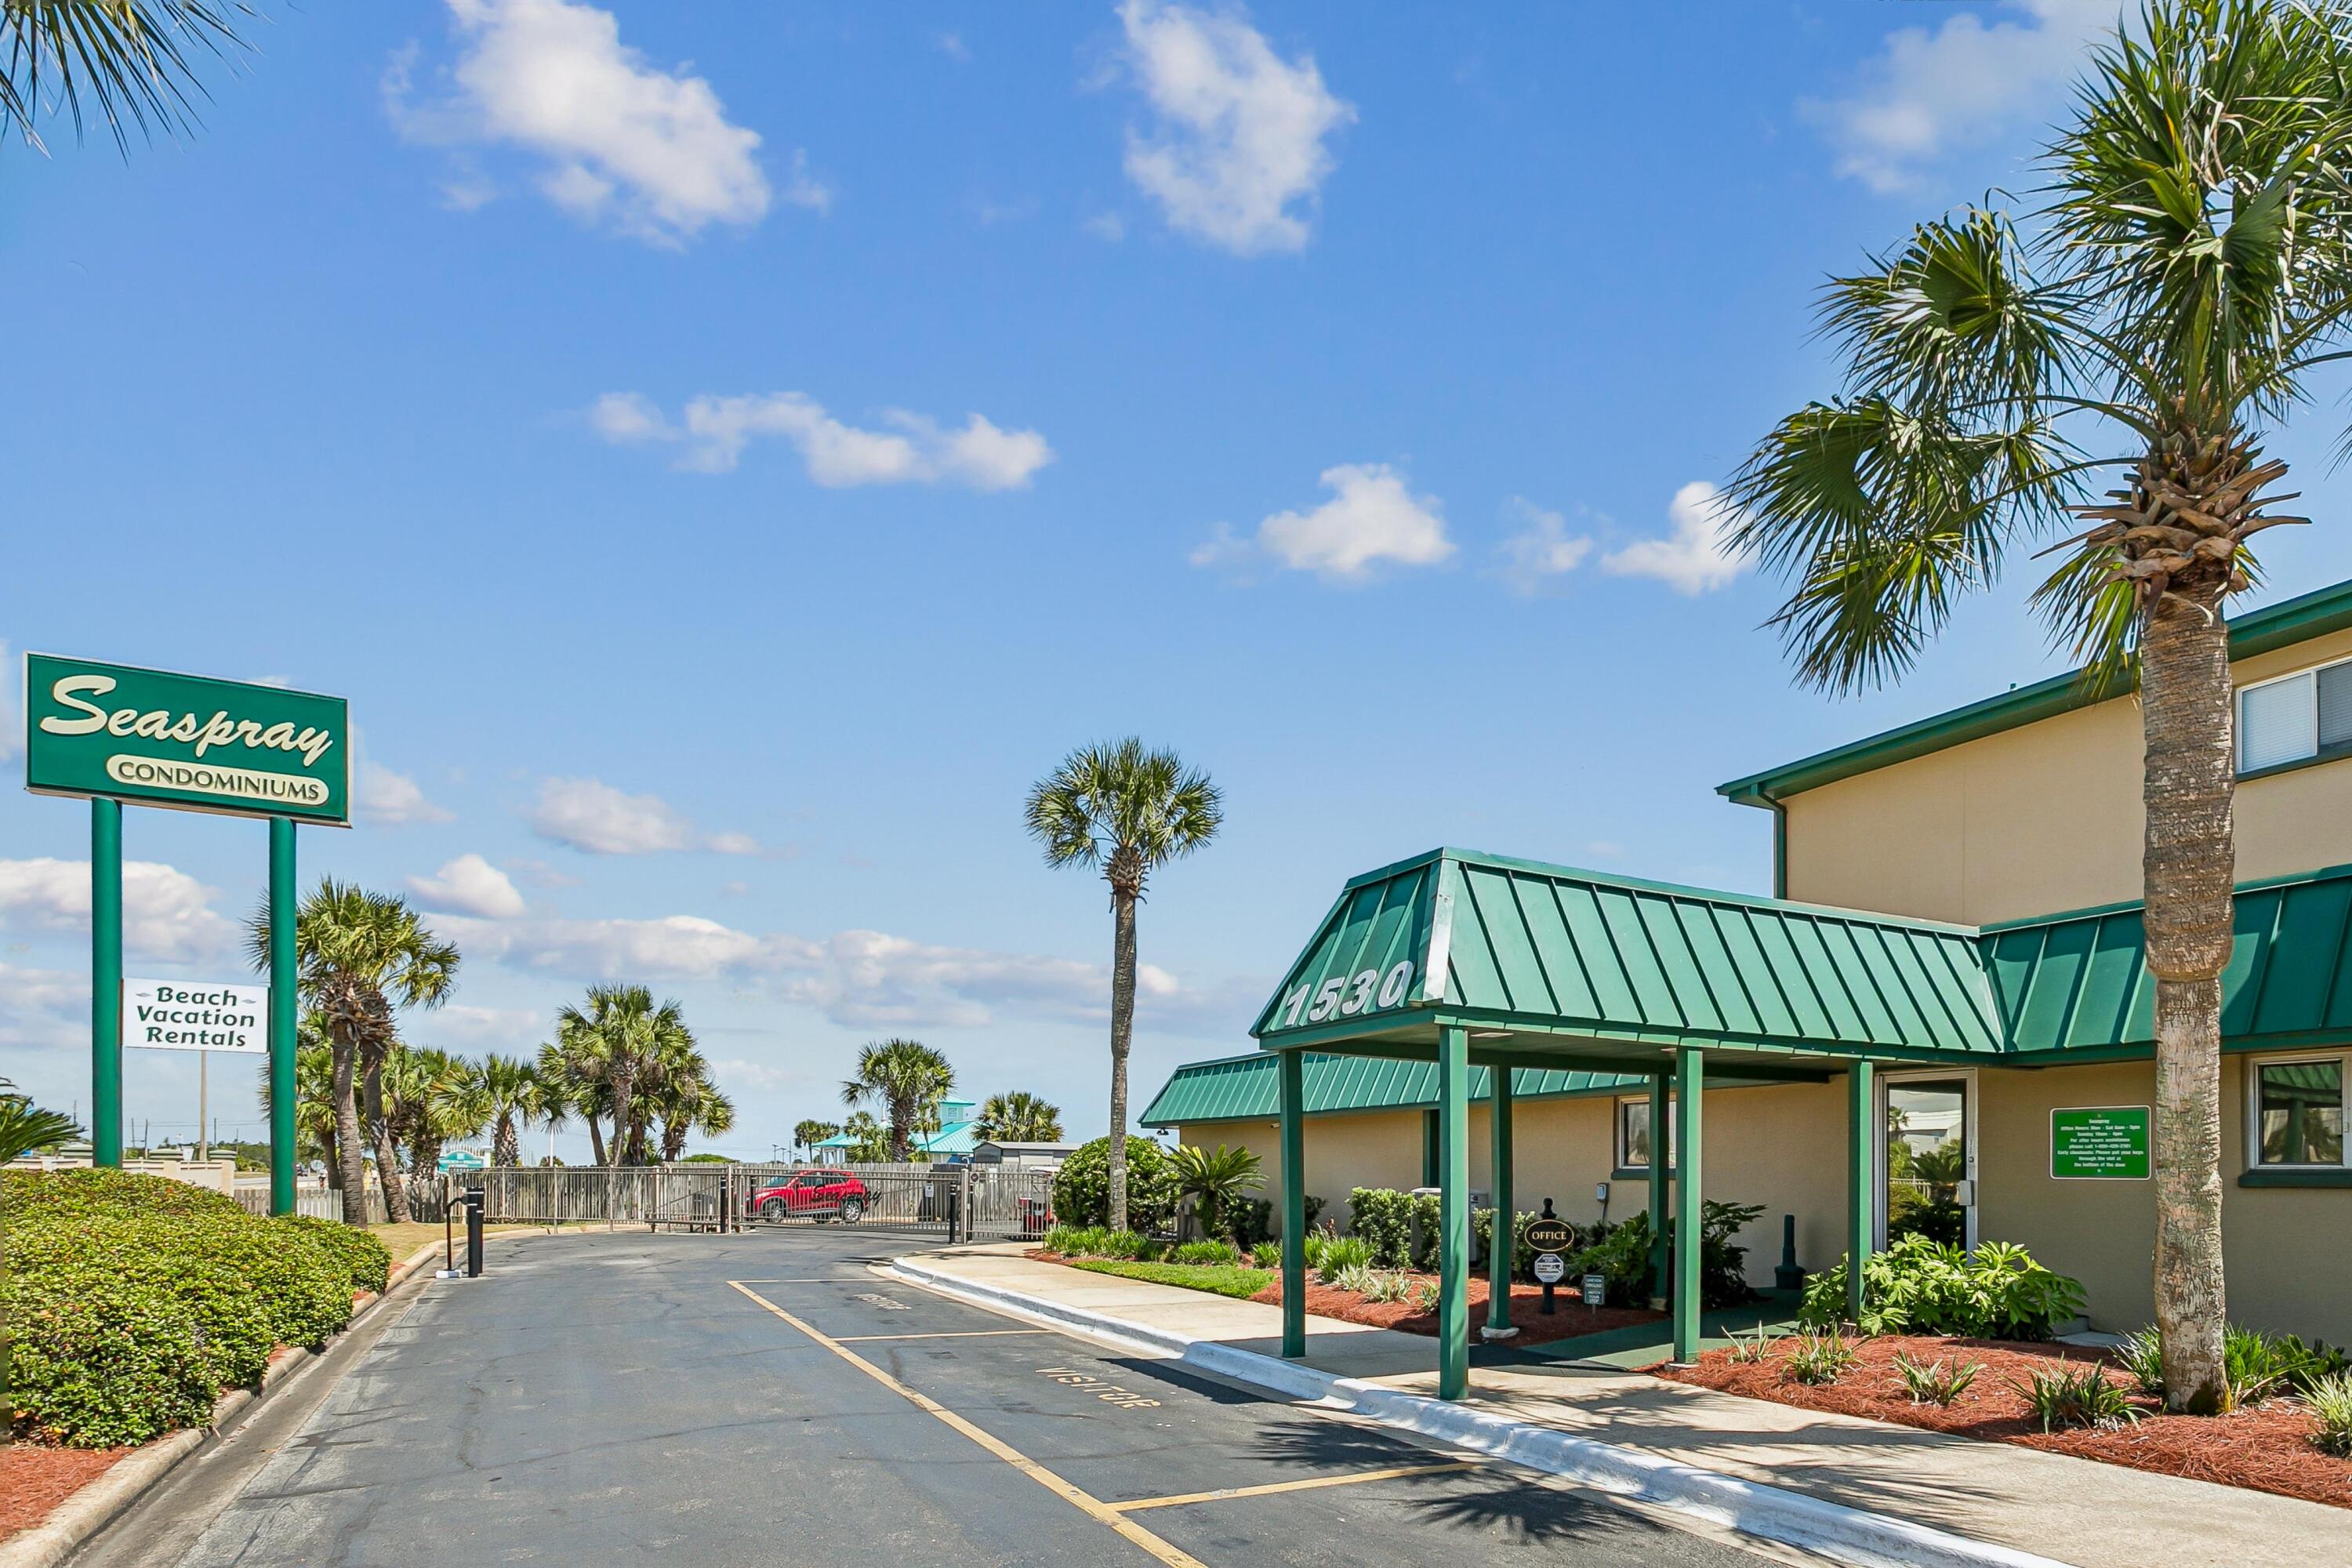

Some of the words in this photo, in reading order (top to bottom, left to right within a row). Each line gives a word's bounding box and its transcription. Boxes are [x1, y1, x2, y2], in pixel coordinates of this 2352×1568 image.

[39, 674, 333, 768] Seaspray
[118, 760, 319, 800] CONDOMINIUMS
[157, 986, 238, 1007] Beach
[1285, 960, 1414, 1026] 1530
[137, 1005, 255, 1027] Vacation
[146, 1026, 246, 1047] Rentals
[1532, 1231, 1567, 1240] OFFICE
[1035, 1367, 1161, 1408] VISITOR
